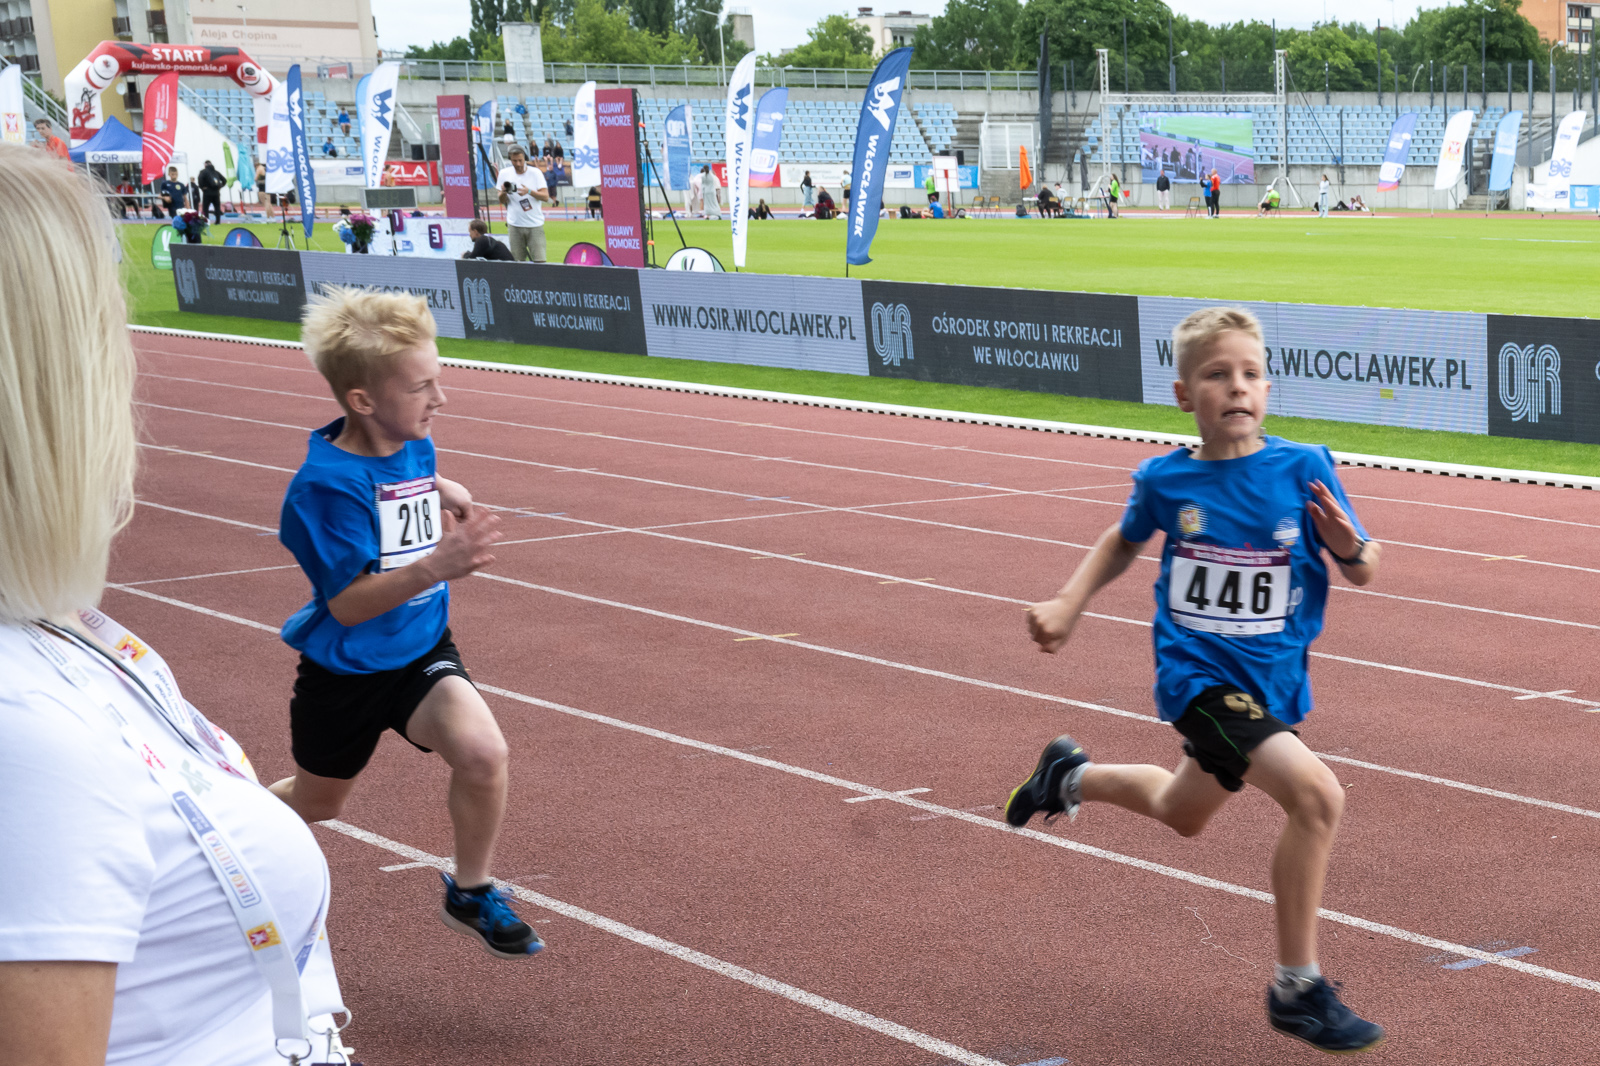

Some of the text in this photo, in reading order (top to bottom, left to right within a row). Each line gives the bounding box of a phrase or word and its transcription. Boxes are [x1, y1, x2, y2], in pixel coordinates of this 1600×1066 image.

[200, 28, 278, 41] Aleja Chopina
[151, 47, 204, 62] START
[131, 61, 228, 73] kujawsko-pomorskie.pl
[440, 107, 460, 118] KUJAWY
[599, 102, 625, 114] KUJAWY
[440, 119, 465, 130] POMORZE
[599, 115, 632, 127] POMORZE
[385, 164, 428, 178] ZLA
[444, 164, 465, 175] KUJAWY
[602, 164, 630, 175] KUJAWY
[445, 176, 470, 187] POMORZE
[603, 176, 636, 188] POMORZE
[853, 133, 880, 238] WŁOCŁAWEK
[430, 228, 441, 244] 3
[607, 225, 634, 236] KUJAWY
[608, 238, 640, 250] POMORZE
[205, 265, 235, 281] OŚRODEK
[235, 269, 258, 285] SPORTU
[262, 271, 297, 287] REKREACJI
[227, 288, 280, 305] WE WŁOCŁAWKU
[504, 284, 631, 311] OŚRODEK SPORTU I REKREACJI
[533, 311, 604, 333] WE WŁOCŁAWKU
[652, 303, 857, 341] WWW.OSIR.WLOCLAWEK.PL
[932, 311, 1122, 348] OŚRODEK SPORTU I REKREACJI
[972, 345, 1080, 372] WE WŁOCŁAWKU
[399, 498, 433, 547] 218
[1185, 564, 1274, 615] 446
